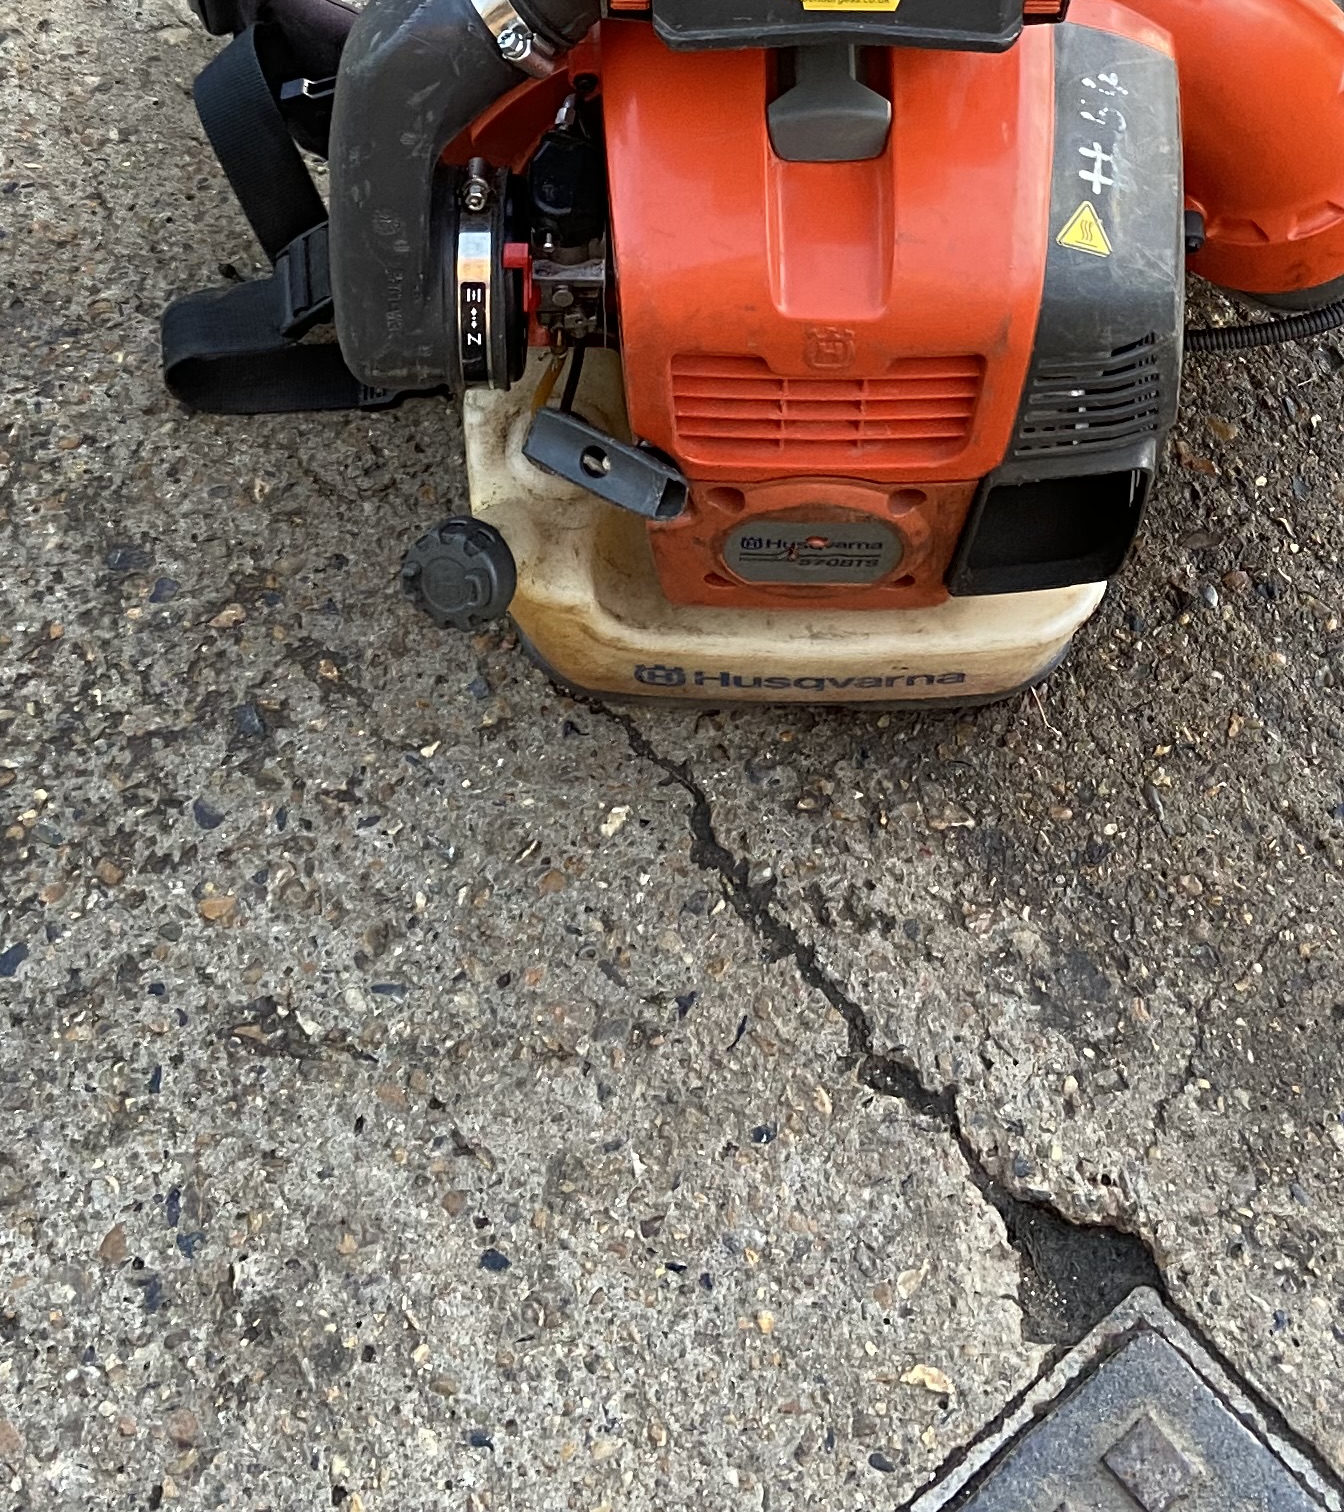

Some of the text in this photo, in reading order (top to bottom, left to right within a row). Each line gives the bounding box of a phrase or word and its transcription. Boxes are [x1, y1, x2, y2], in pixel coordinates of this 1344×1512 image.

[767, 538, 882, 550] Husvarna
[799, 558, 879, 569] 570BTS
[694, 670, 966, 691] Husqvarna
